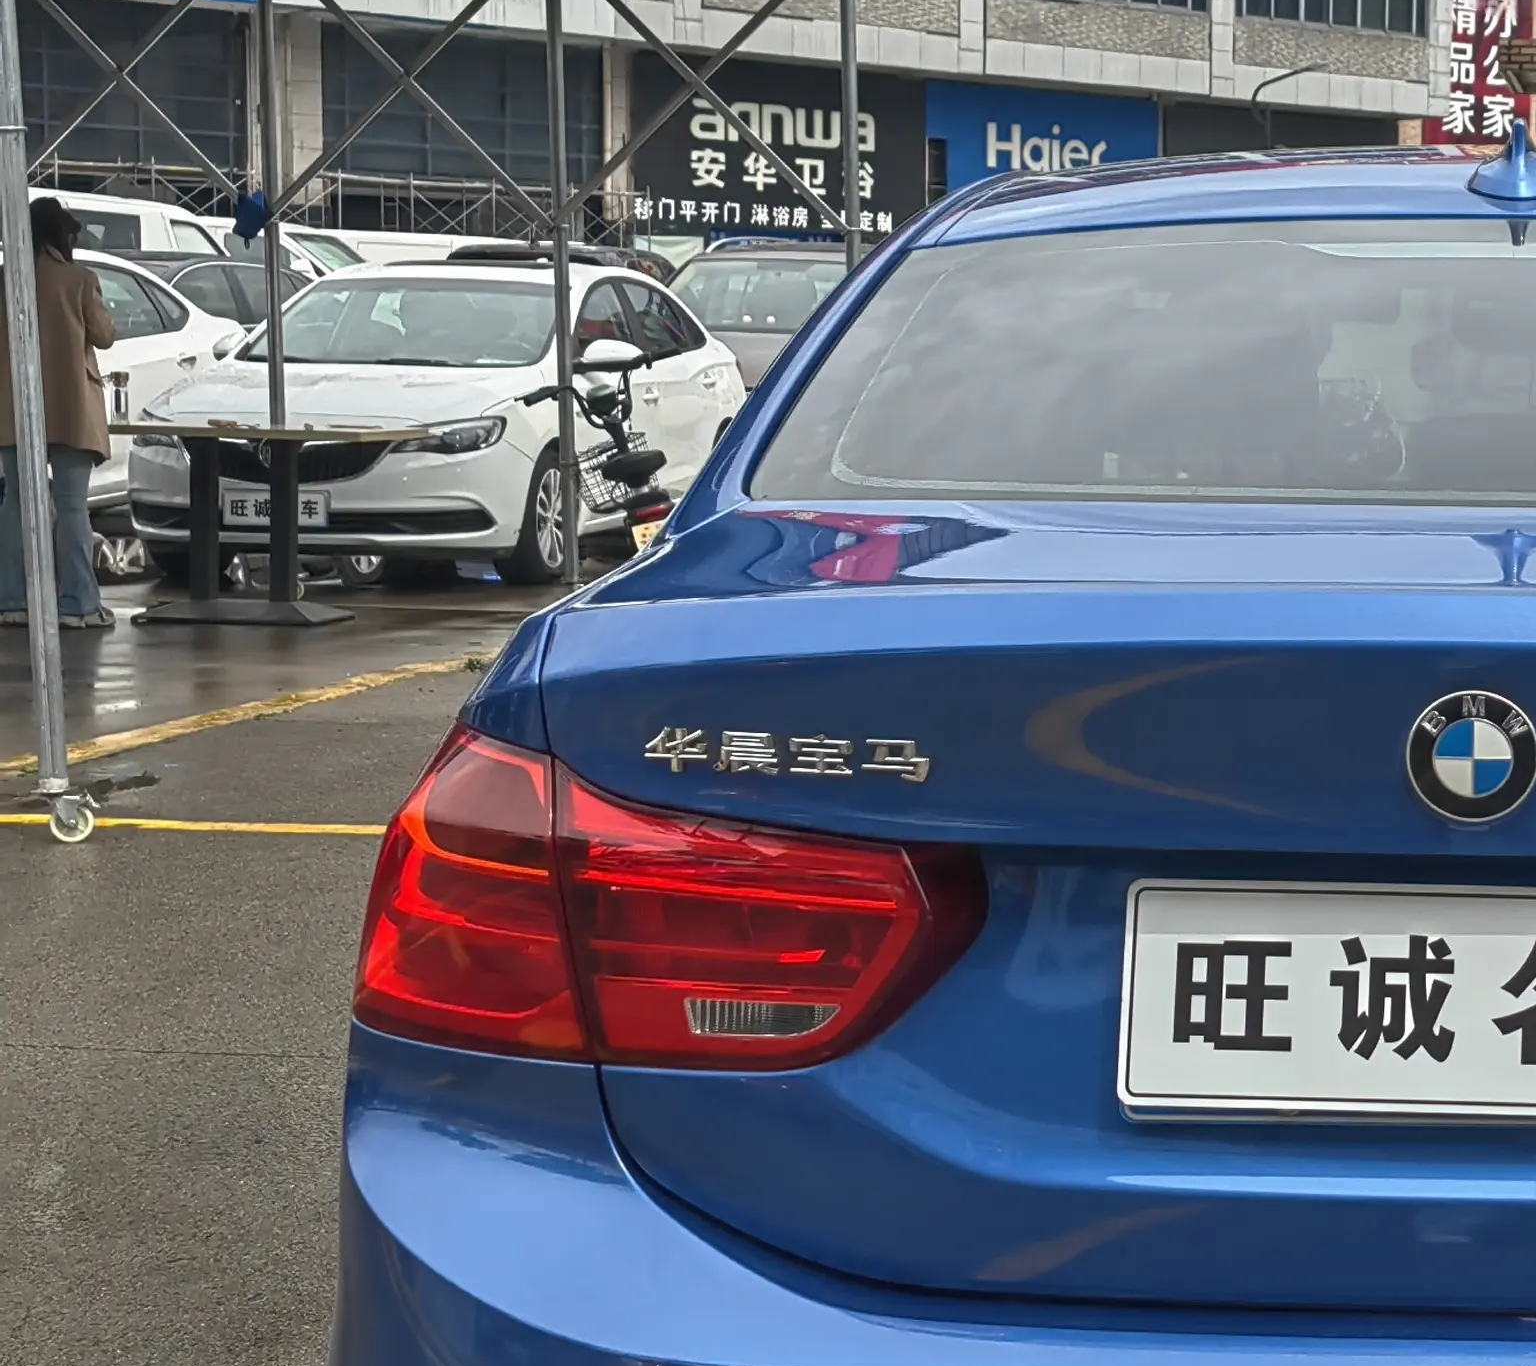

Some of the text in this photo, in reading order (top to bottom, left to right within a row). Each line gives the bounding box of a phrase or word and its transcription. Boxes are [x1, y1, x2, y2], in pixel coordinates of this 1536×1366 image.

[986, 121, 1108, 172] Haier
[634, 197, 741, 223] 移门平开门
[751, 203, 808, 228] 淋浴房
[230, 499, 319, 520] 旺诚车
[1420, 695, 1528, 738] BMW
[644, 726, 931, 783] 华晨宝马
